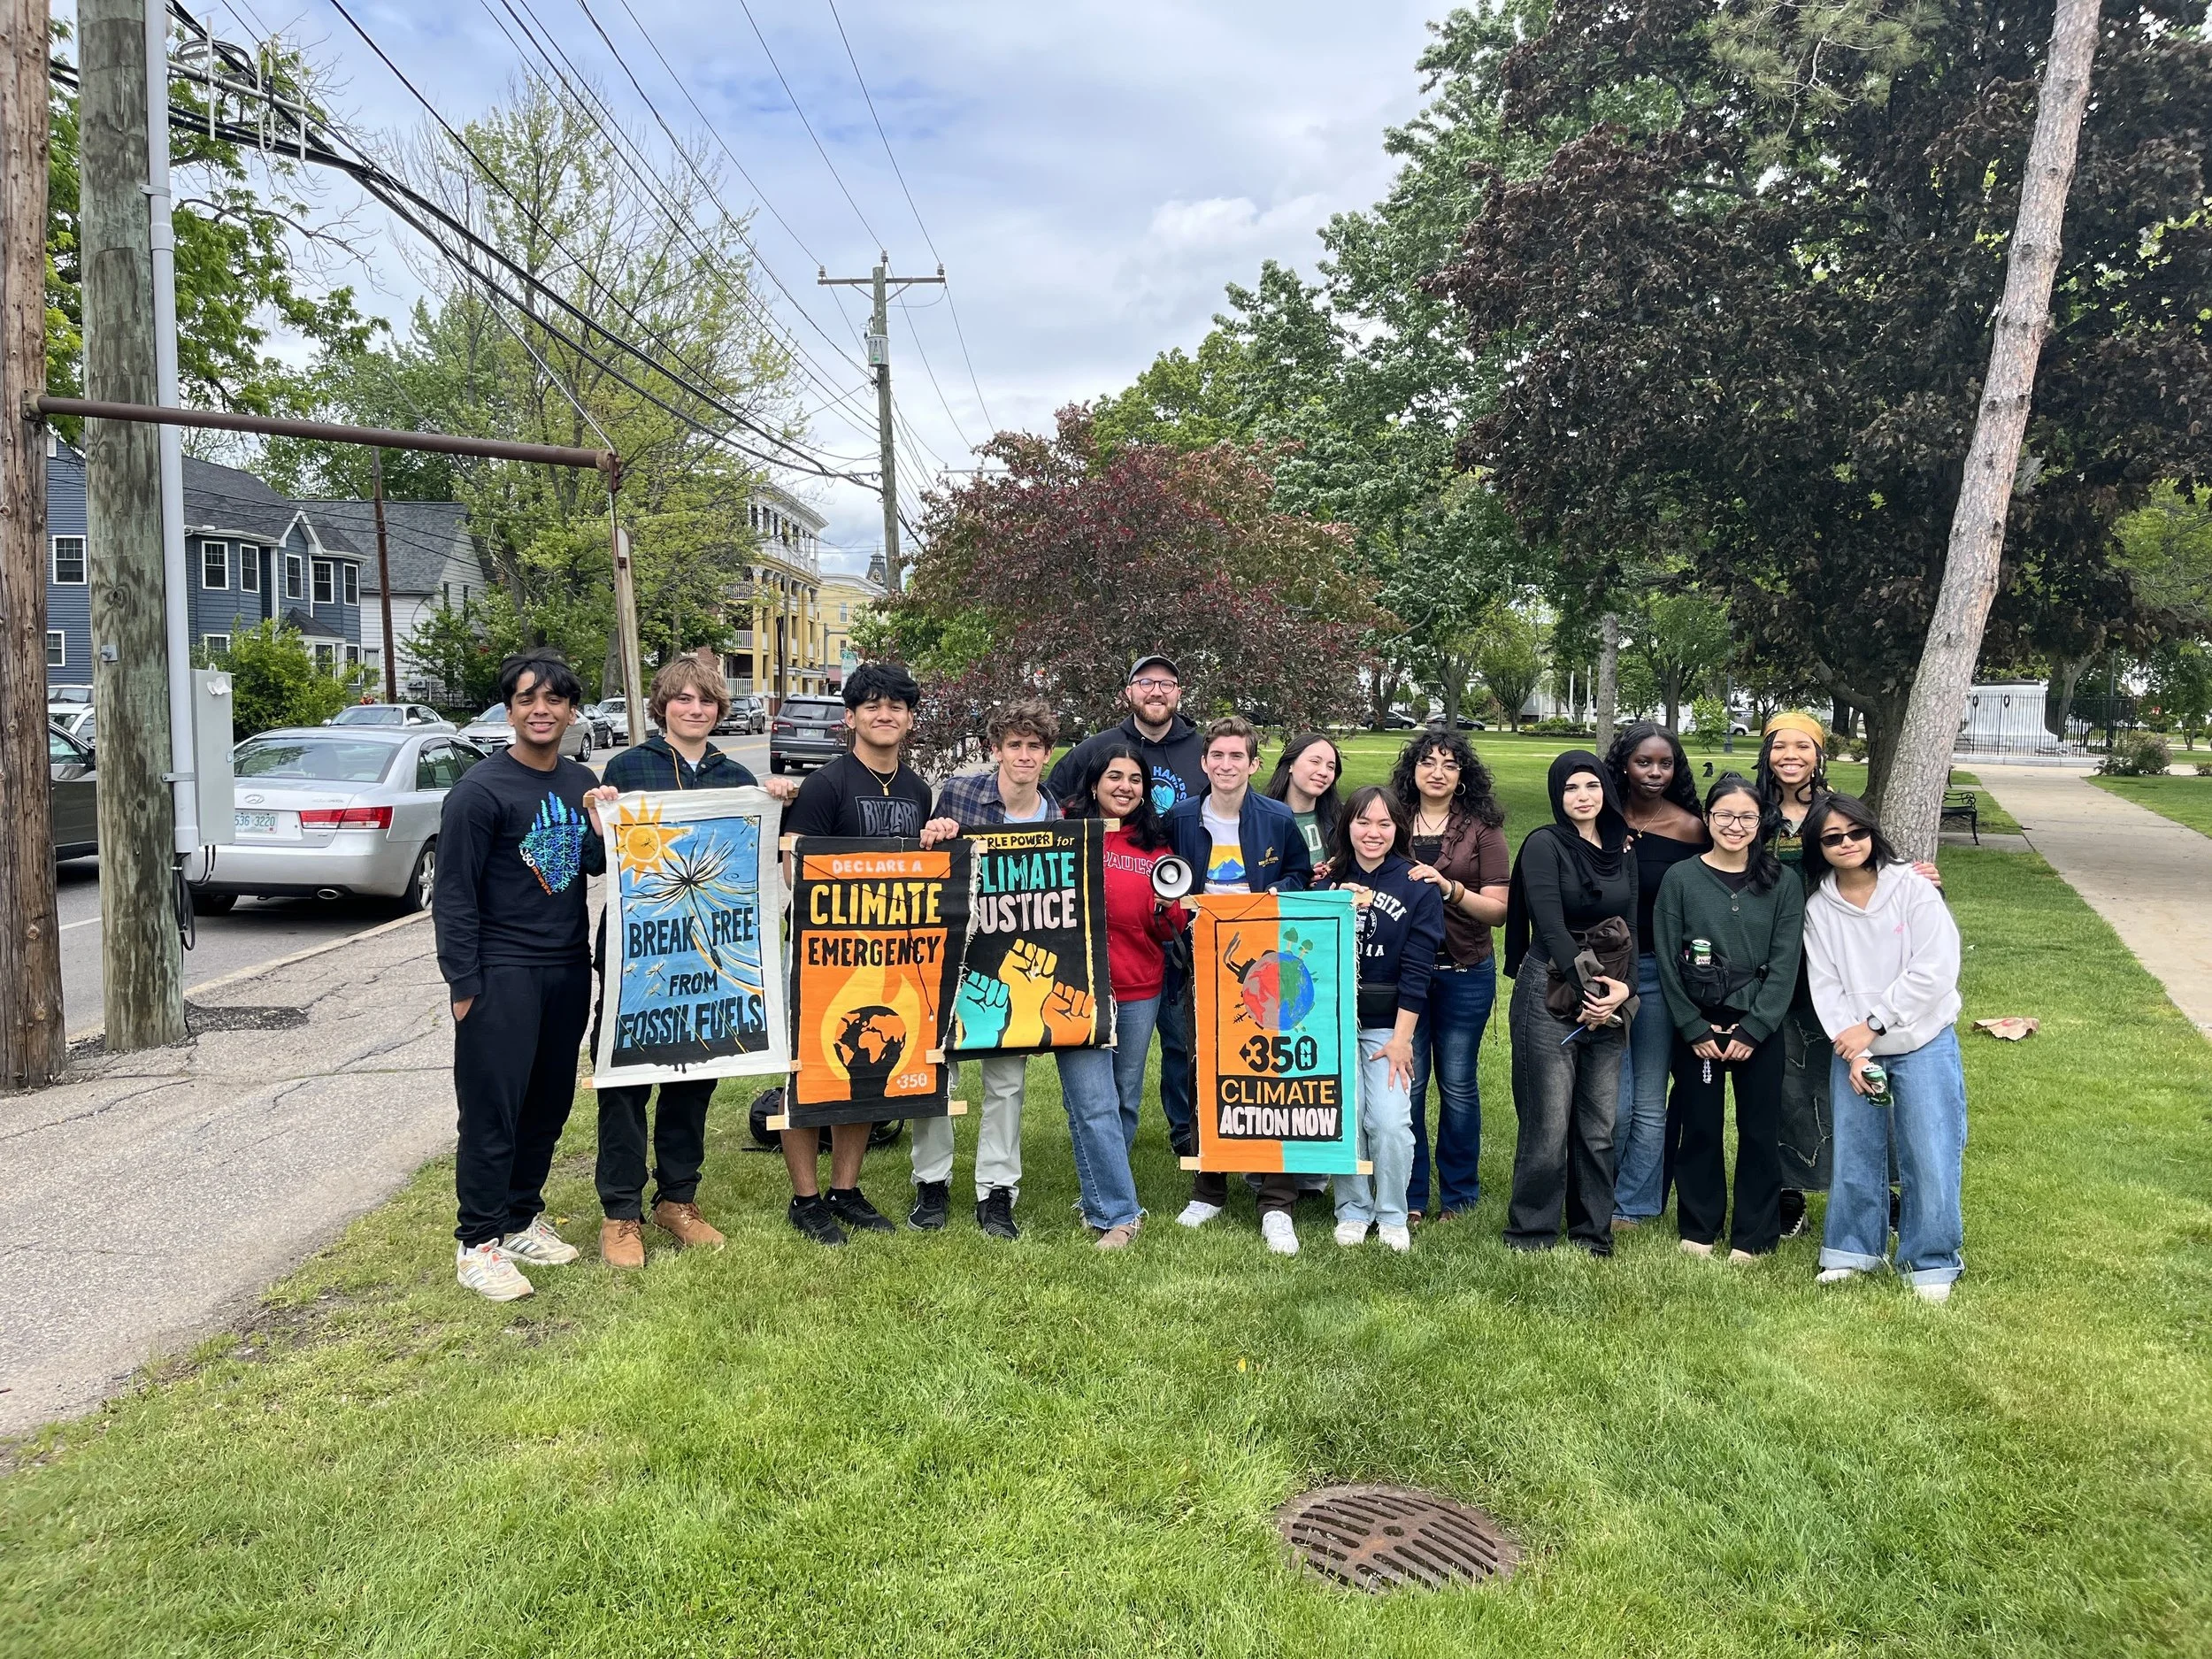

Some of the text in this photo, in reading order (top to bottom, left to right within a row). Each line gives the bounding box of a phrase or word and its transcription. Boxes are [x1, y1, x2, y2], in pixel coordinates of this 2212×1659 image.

[254, 816, 276, 827] 3220
[860, 800, 919, 836] BLIZZARD
[1010, 834, 1050, 847] POWER
[1056, 836, 1075, 847] for
[832, 859, 923, 874] DECLARE A
[978, 852, 1076, 893] LIMATE
[810, 882, 943, 926] CLIMATE
[979, 888, 1077, 934] USTICE
[629, 907, 754, 958] BREAK FREE
[808, 935, 941, 966] EMERGENCY
[669, 969, 718, 996] FROM
[619, 995, 764, 1047] FOSSIL FUELS
[1248, 1035, 1317, 1073] 350
[899, 1072, 927, 1089] 350
[1221, 1079, 1335, 1105] CLIMATE
[1220, 1105, 1338, 1136] ACTION NOW
